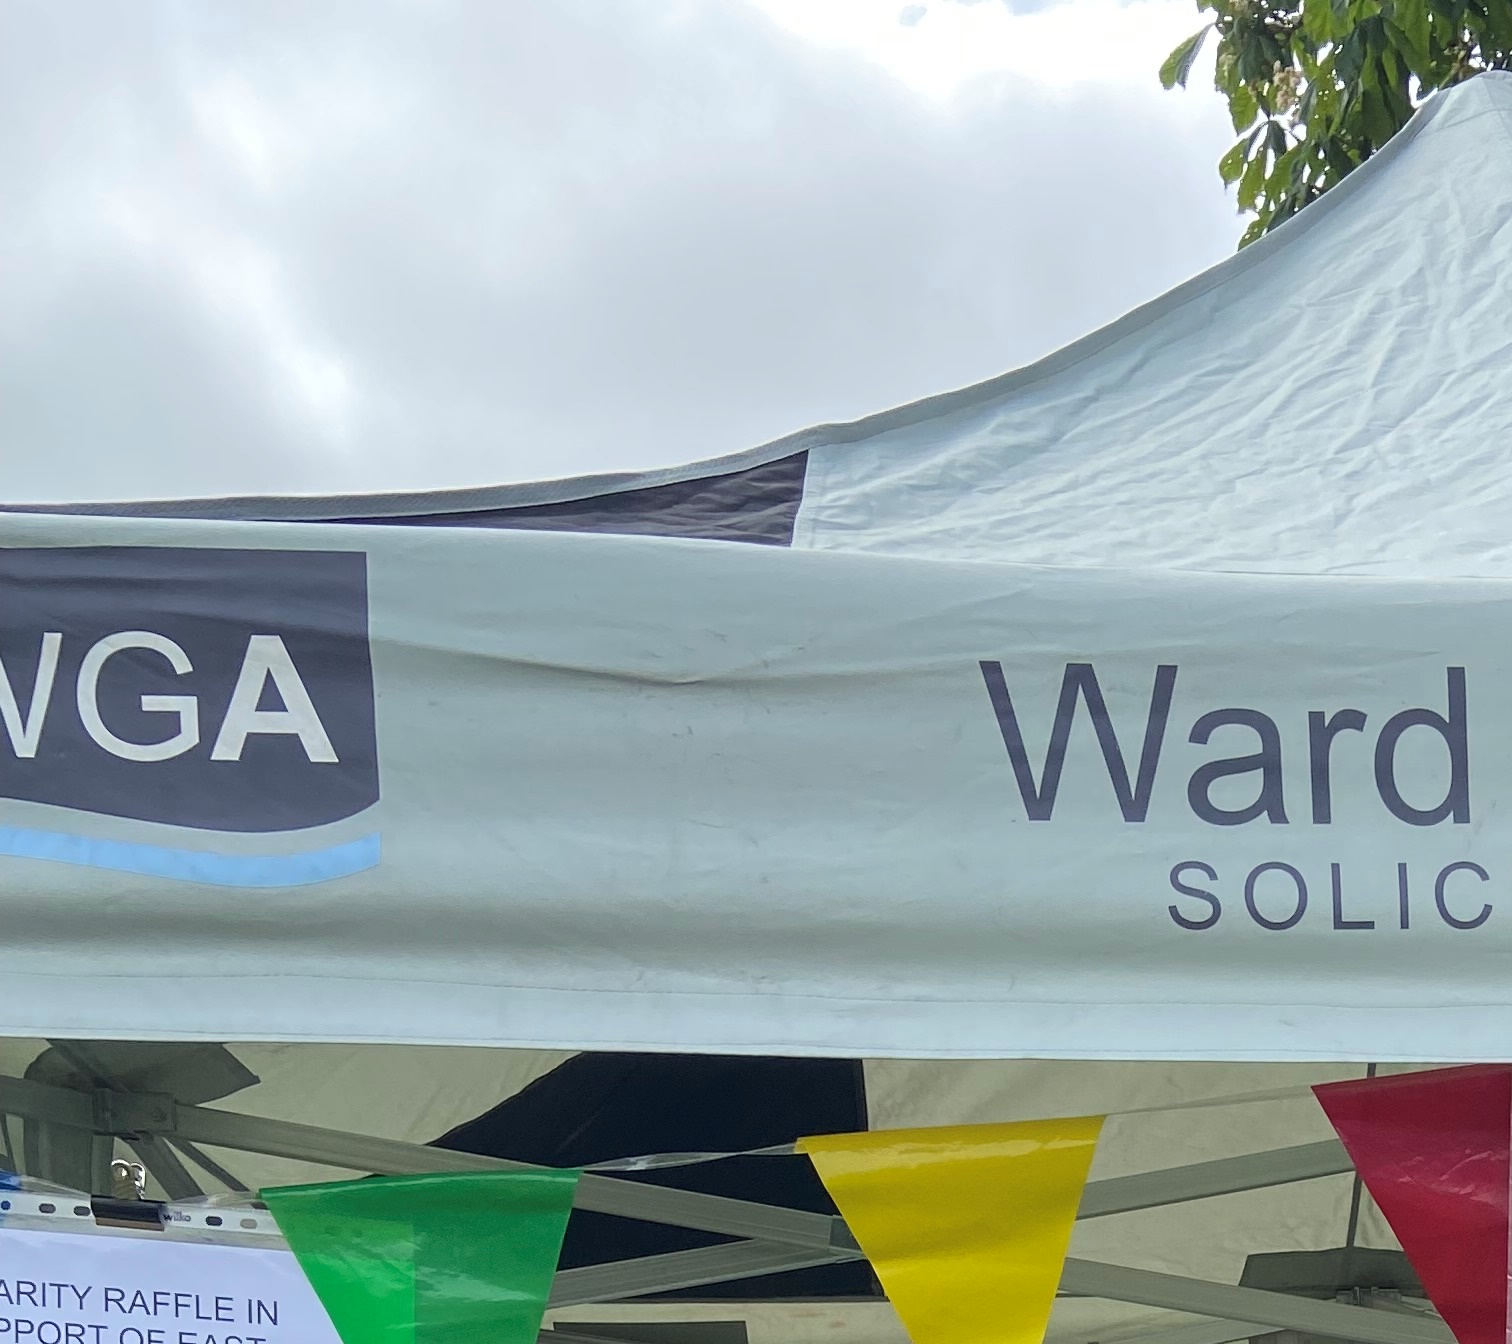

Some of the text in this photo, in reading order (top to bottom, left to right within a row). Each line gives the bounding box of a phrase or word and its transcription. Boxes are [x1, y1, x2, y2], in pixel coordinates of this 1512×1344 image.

[979, 660, 1471, 827] Ward
[103, 1287, 235, 1323] RAFFLE
[247, 1298, 278, 1326] IN
